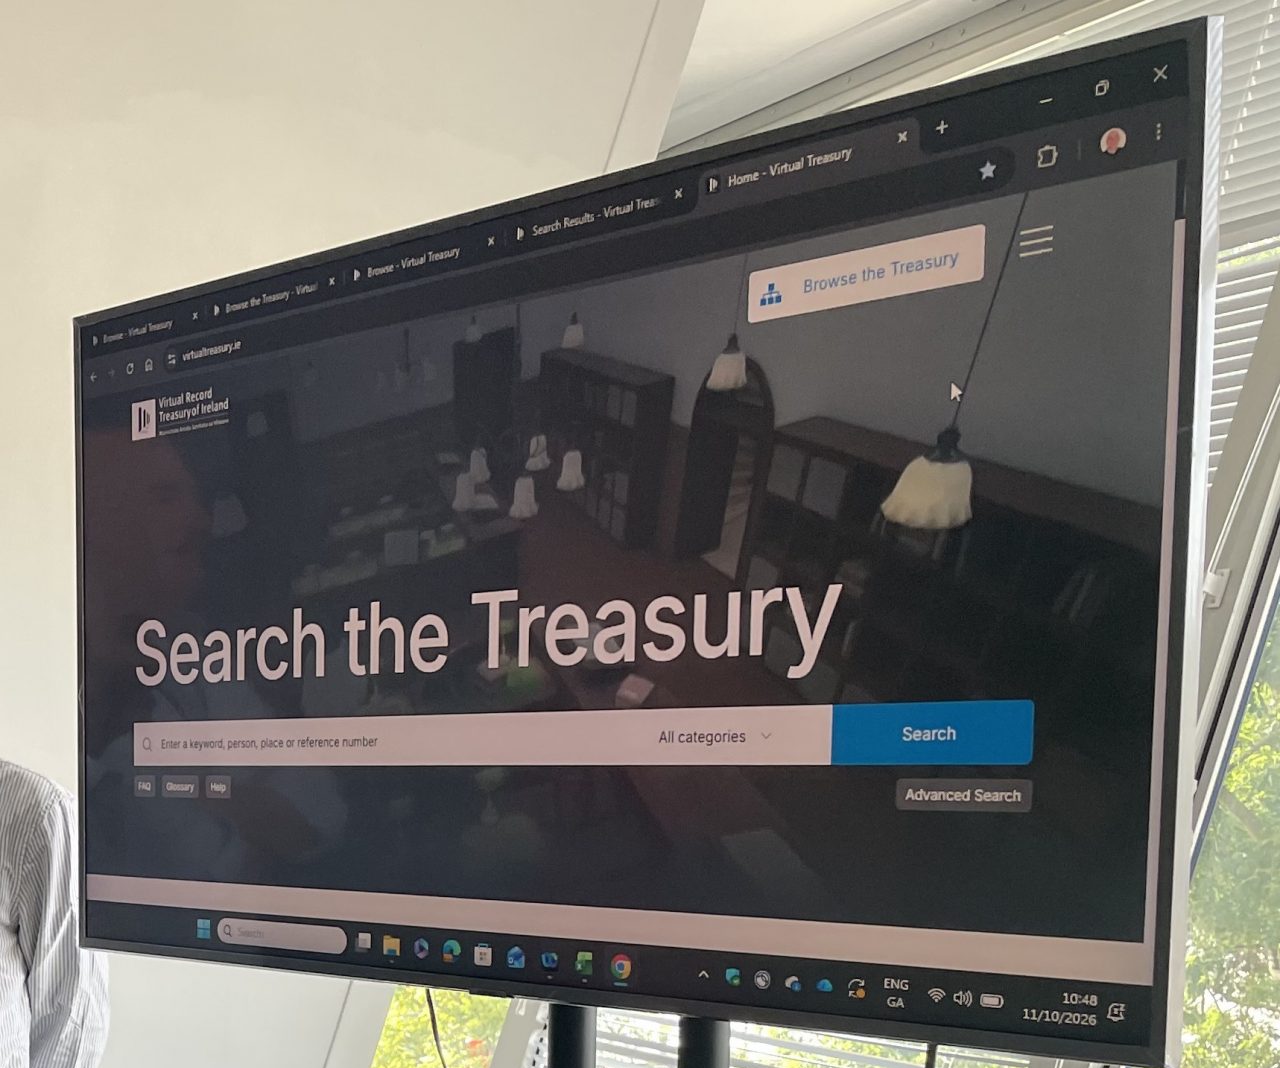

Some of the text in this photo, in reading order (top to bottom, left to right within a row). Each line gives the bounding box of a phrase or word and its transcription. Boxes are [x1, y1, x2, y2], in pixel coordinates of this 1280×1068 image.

[728, 170, 760, 187] Home
[769, 157, 805, 176] Virtual
[806, 148, 853, 167] Treasury
[532, 220, 561, 236] Search
[563, 212, 595, 228] Results
[603, 201, 634, 218] Virtual
[367, 266, 395, 278] Browse
[401, 254, 426, 269] Virtual
[428, 247, 461, 263] Treasury
[803, 250, 959, 294] Browse the Treasury
[159, 386, 213, 408] Virtual Record
[159, 397, 229, 422] Treasury of Ireland
[135, 583, 843, 686] Search the Treasury
[161, 735, 378, 751] Enter a keyword, person, place or reference number
[658, 728, 746, 747] All categories
[902, 726, 956, 742] Search
[210, 782, 226, 794] Help
[905, 788, 1022, 803] Advanced Search
[883, 977, 909, 990] ENG
[886, 996, 905, 1008] GA
[1062, 992, 1098, 1006] 10:48
[1022, 1008, 1097, 1025] 11/10/2026
